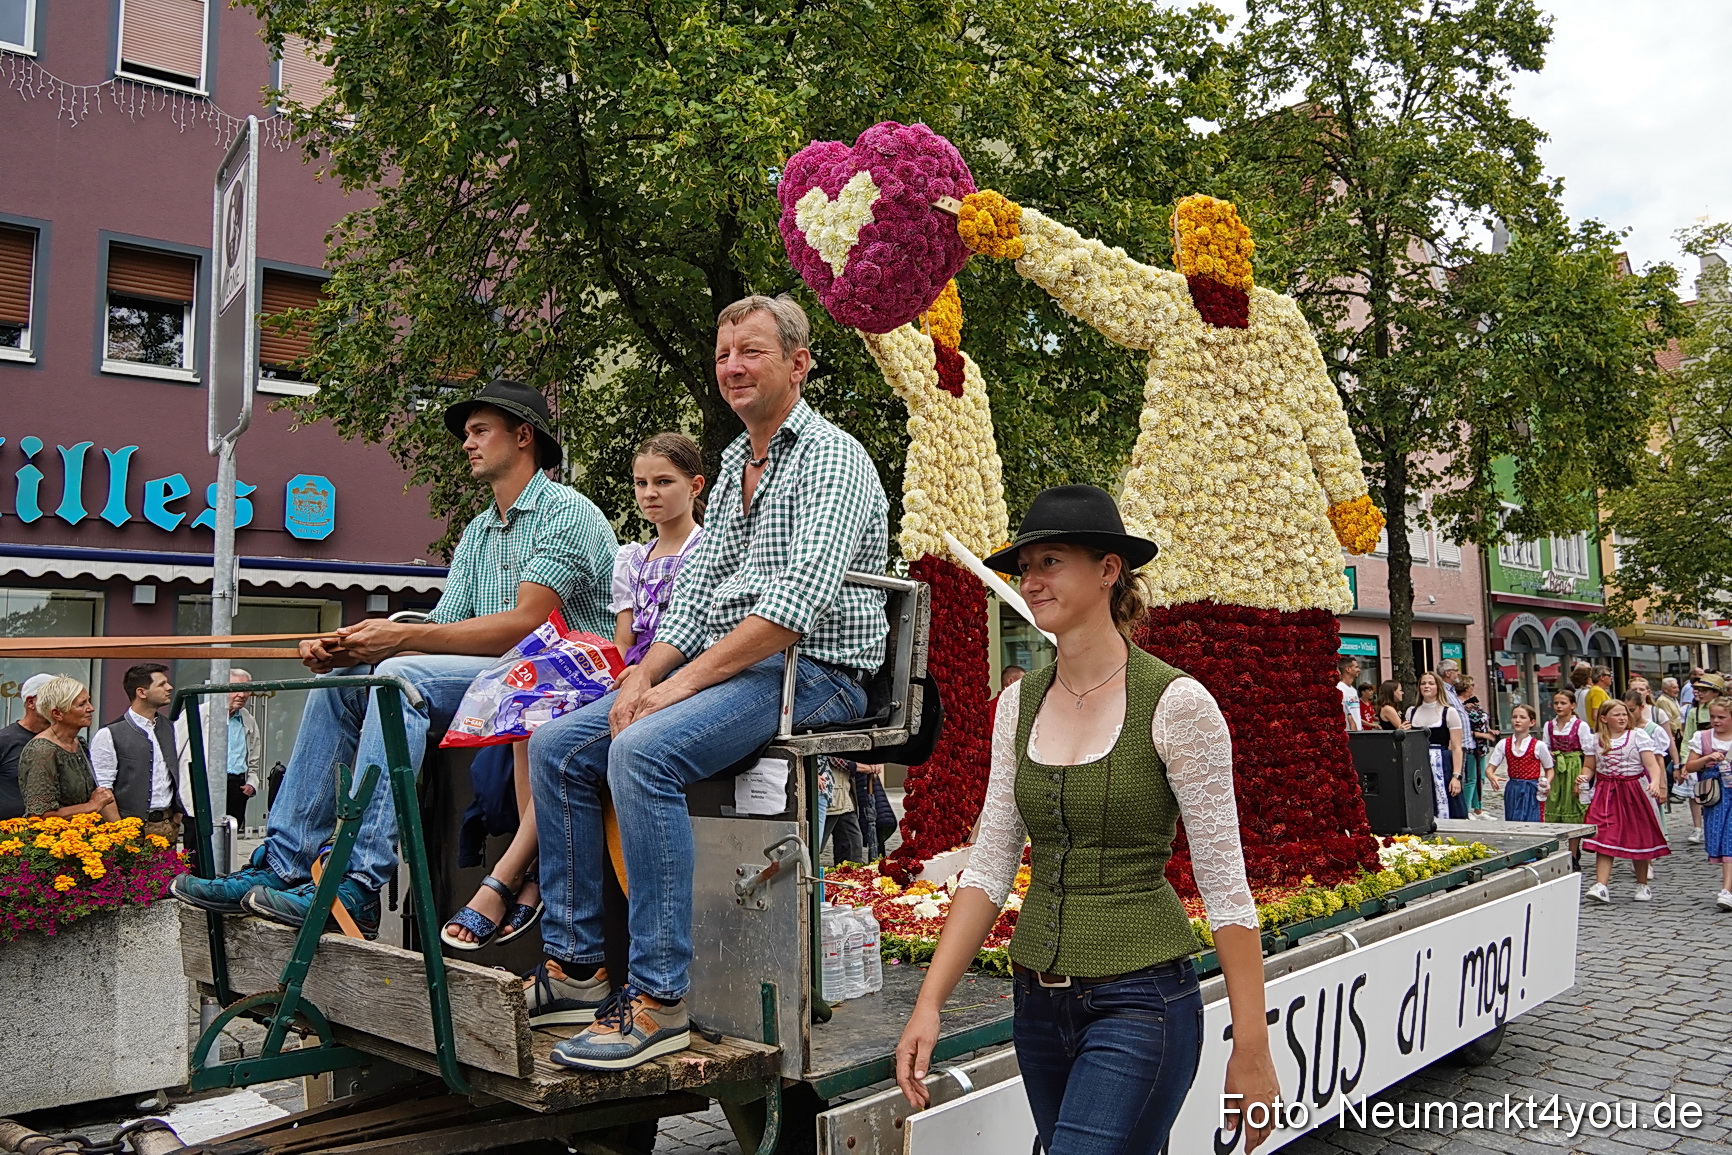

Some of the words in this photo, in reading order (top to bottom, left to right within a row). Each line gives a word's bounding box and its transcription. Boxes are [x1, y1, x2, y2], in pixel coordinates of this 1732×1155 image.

[225, 264, 240, 300] ZONE
[0, 435, 258, 532] illes
[514, 664, 533, 682] 120
[1397, 949, 1432, 1055] di
